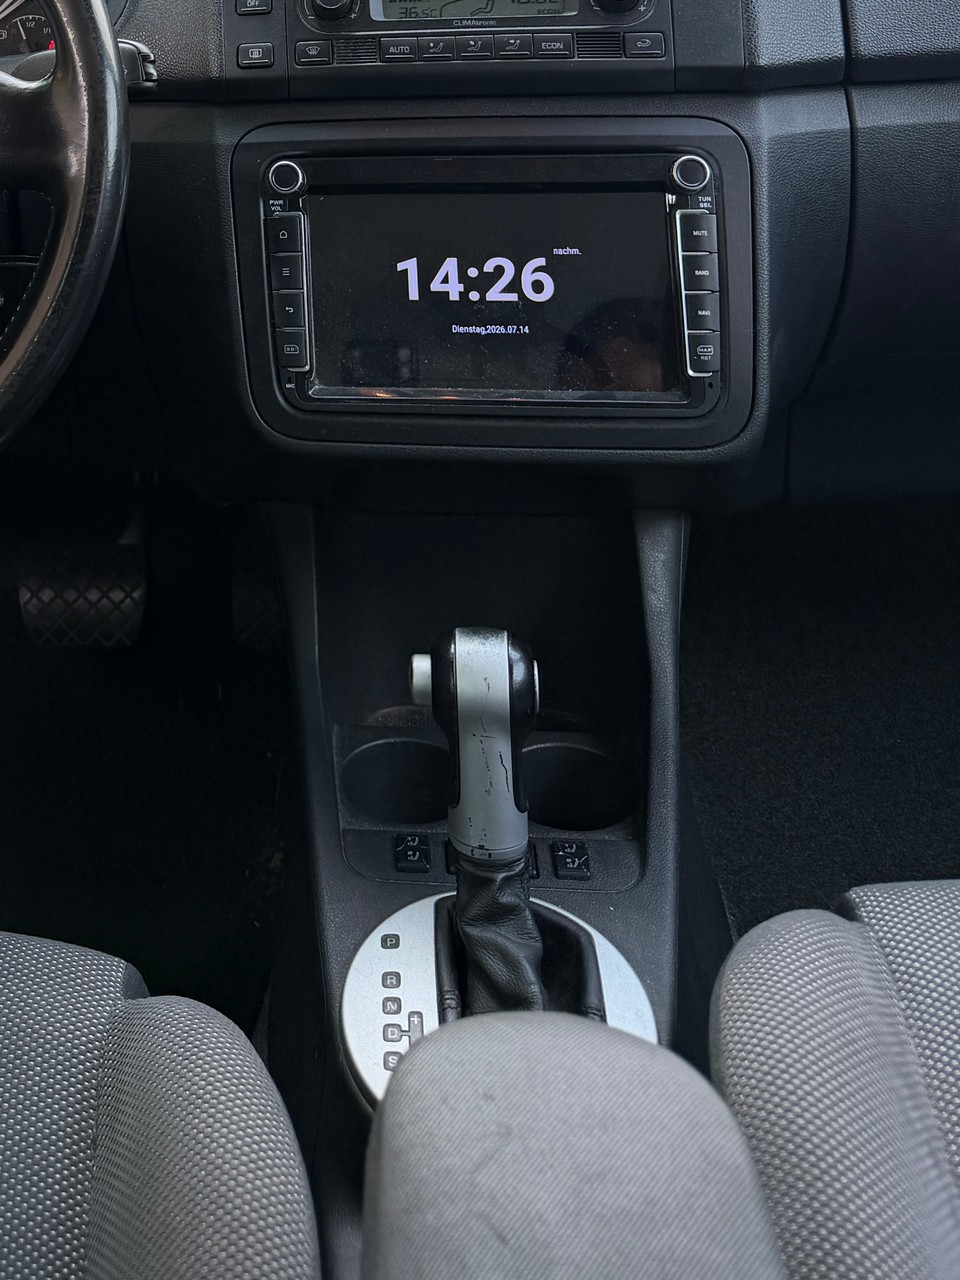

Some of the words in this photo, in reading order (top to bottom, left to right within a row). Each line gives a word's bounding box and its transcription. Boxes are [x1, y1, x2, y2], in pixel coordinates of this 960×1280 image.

[389, 45, 410, 54] AUTO
[541, 41, 564, 50] ECON
[553, 246, 582, 255] nachm.
[396, 256, 555, 302] 14:26
[386, 937, 396, 947] P
[386, 975, 397, 985] R
[387, 1001, 398, 1011] N
[387, 1027, 398, 1039] D
[388, 1055, 398, 1067] S
